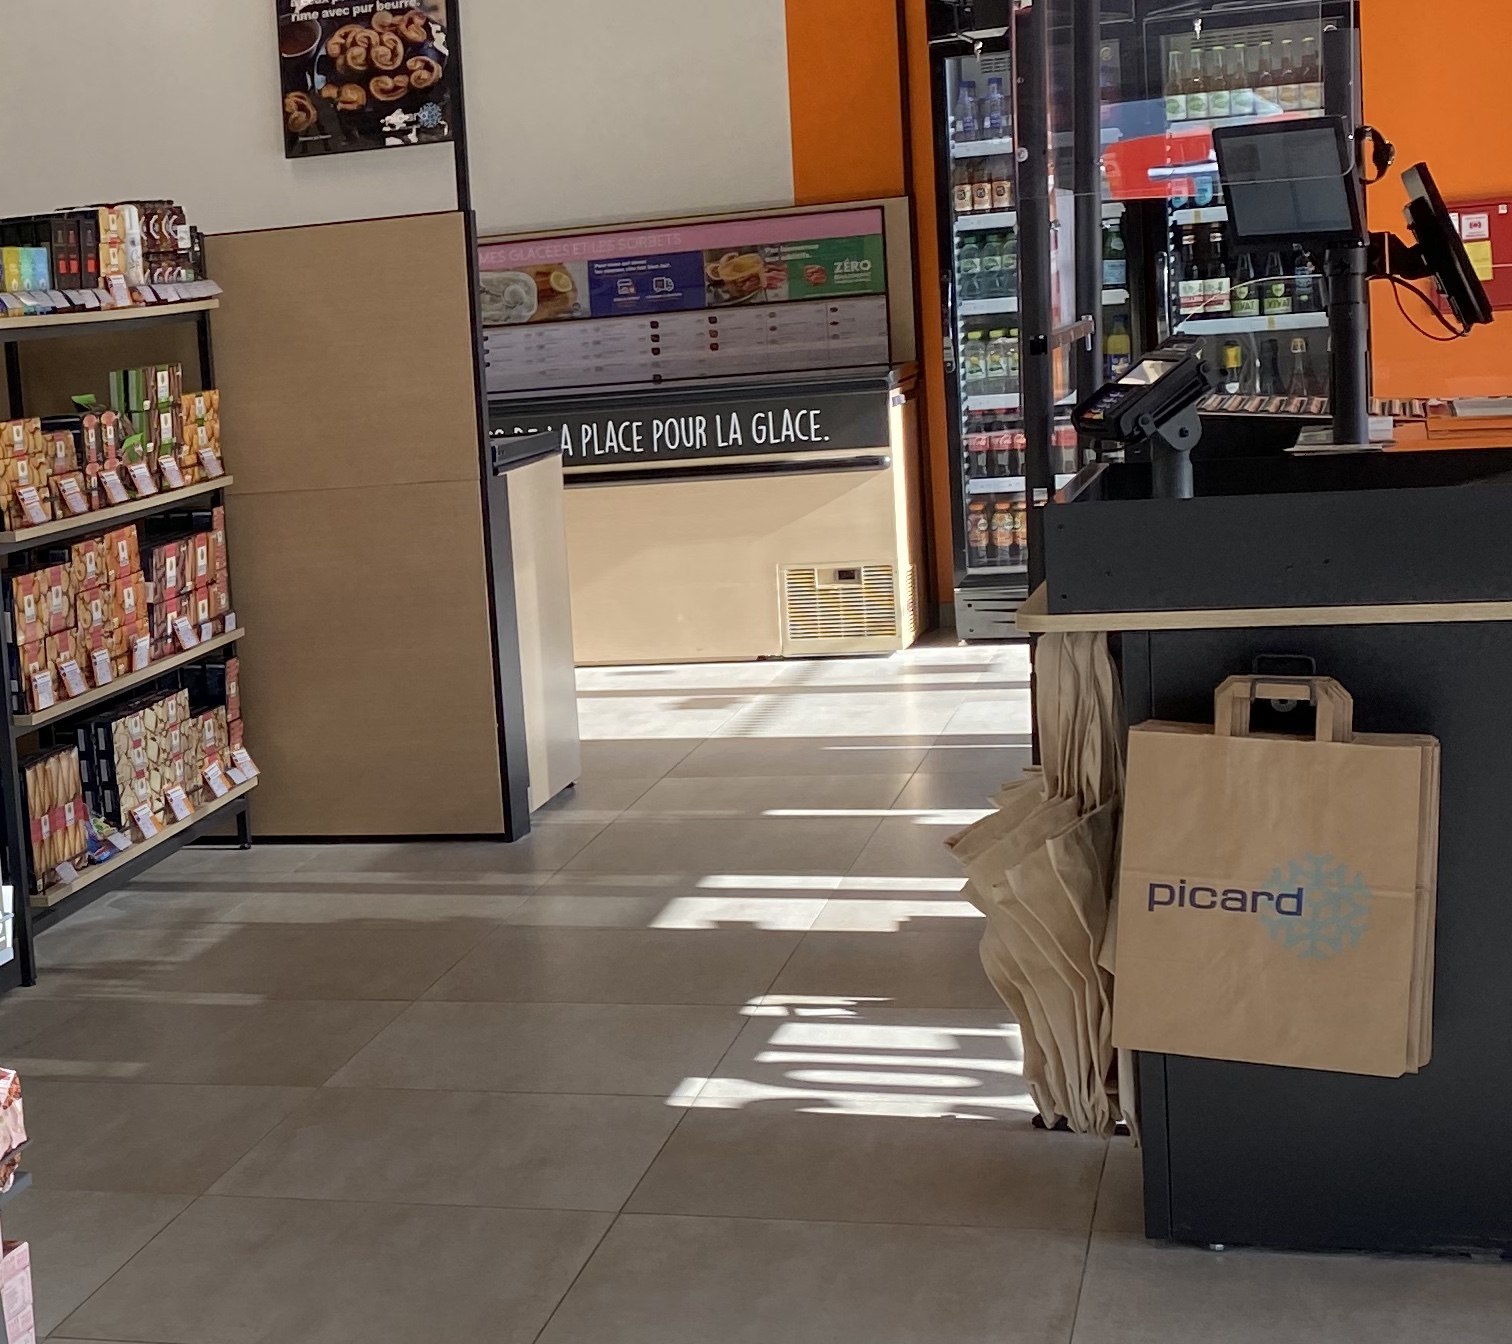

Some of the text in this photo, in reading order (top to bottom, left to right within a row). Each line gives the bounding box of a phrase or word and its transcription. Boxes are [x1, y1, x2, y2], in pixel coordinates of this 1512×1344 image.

[291, 9, 319, 22] rime
[321, 7, 350, 19] avec
[352, 3, 374, 17] pur
[592, 239, 615, 252] LES
[618, 233, 682, 251] SORBETS
[834, 258, 871, 273] ZÉRO
[582, 420, 644, 456] PLACE
[653, 415, 707, 452] POUR
[716, 412, 742, 447] LA
[751, 408, 830, 444] GLACE.
[1148, 879, 1304, 916] picard
